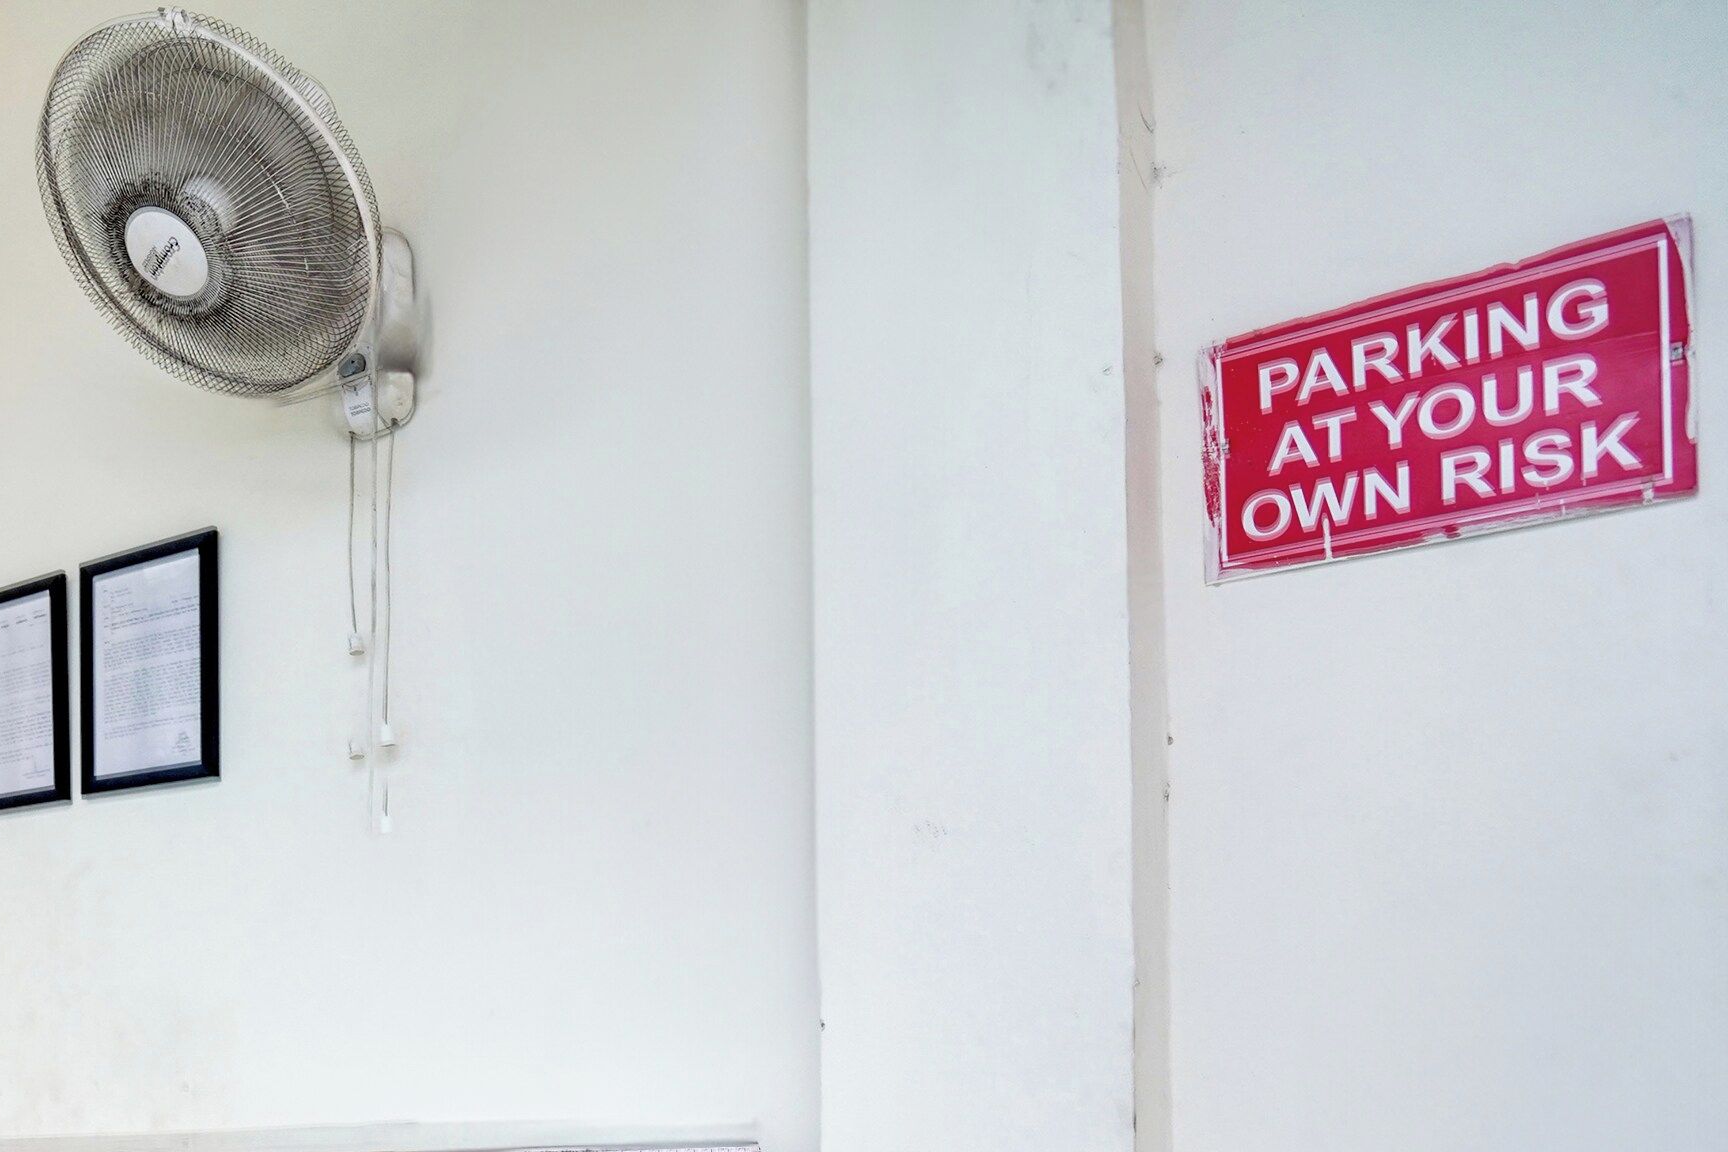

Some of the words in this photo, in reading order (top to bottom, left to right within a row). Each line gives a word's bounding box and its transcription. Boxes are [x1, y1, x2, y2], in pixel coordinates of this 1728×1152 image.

[148, 236, 180, 281] Crompton
[1257, 278, 1610, 415] PARKING
[1240, 460, 1412, 542] OWN
[1439, 411, 1643, 506] RISK
[1267, 407, 1358, 476] AT
[1367, 352, 1603, 450] YOUR
